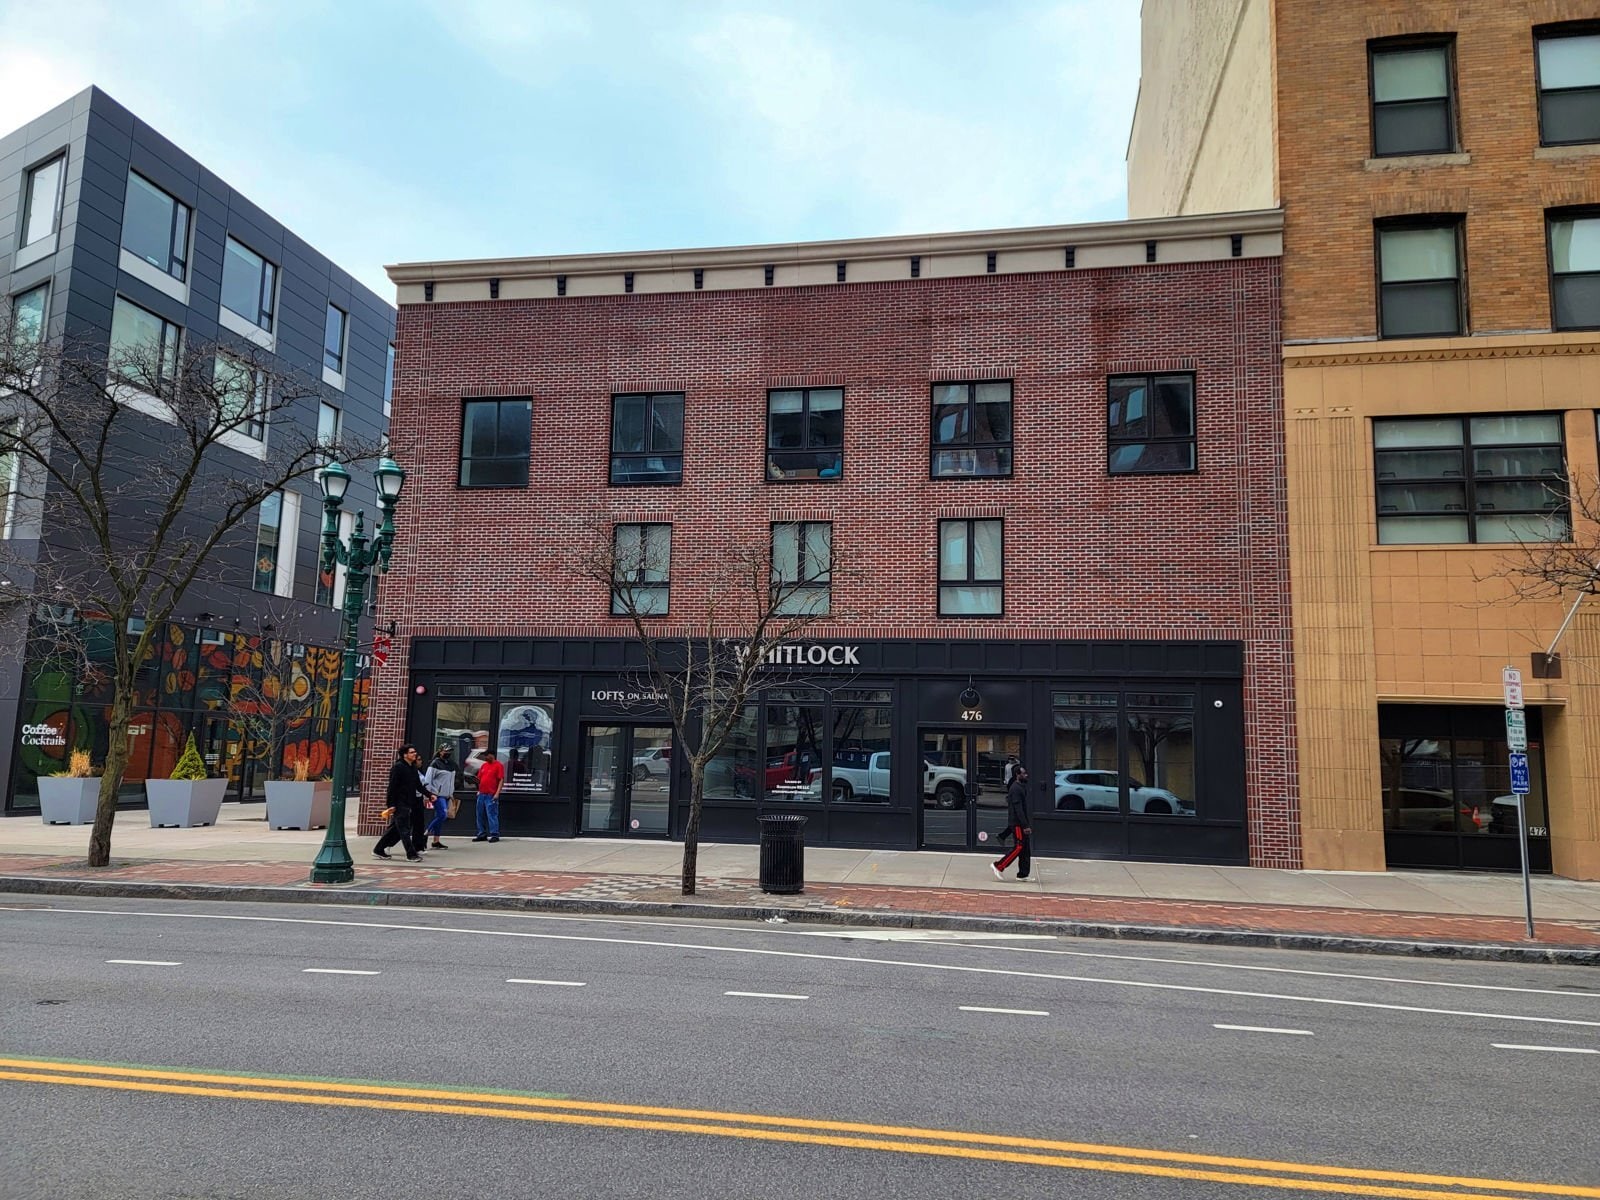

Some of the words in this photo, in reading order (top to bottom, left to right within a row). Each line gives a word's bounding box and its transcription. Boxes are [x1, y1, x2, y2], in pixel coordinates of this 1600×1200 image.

[1508, 672, 1517, 681] NO
[591, 690, 625, 700] LOFTS
[627, 692, 640, 700] ON
[961, 710, 983, 721] 476
[22, 723, 58, 735] Coffee
[21, 735, 66, 746] Cocktails
[1531, 827, 1546, 836] 472
